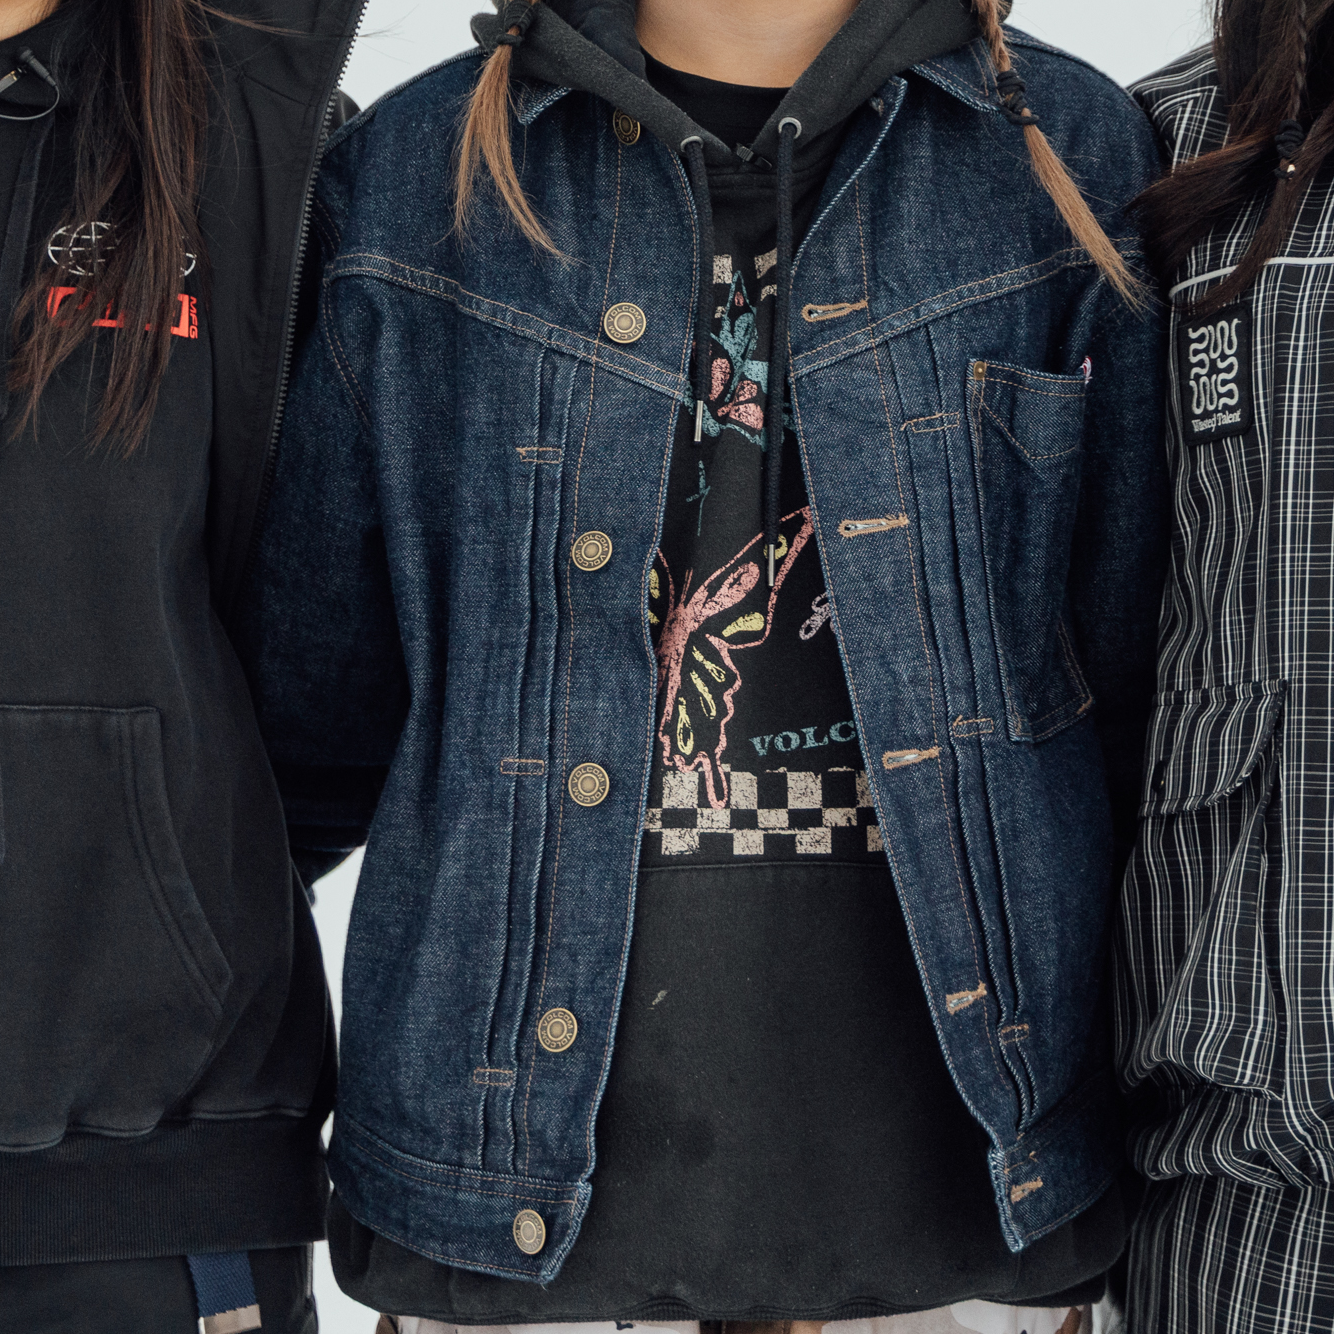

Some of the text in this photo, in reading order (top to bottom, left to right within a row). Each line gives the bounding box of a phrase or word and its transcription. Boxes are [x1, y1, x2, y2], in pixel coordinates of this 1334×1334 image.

[189, 295, 199, 340] MFG
[608, 305, 642, 322] VOLCOM
[608, 323, 643, 340] VOLCOM
[1217, 410, 1241, 426] Talent
[578, 534, 608, 551] VOLCOM
[575, 550, 606, 567] VOLCOM
[748, 719, 857, 757] VOLC
[572, 766, 605, 783] VOLCOM
[572, 785, 606, 803] VOLCOM
[542, 1011, 574, 1029] VOLCOM
[541, 1030, 573, 1048] VOLCOM
